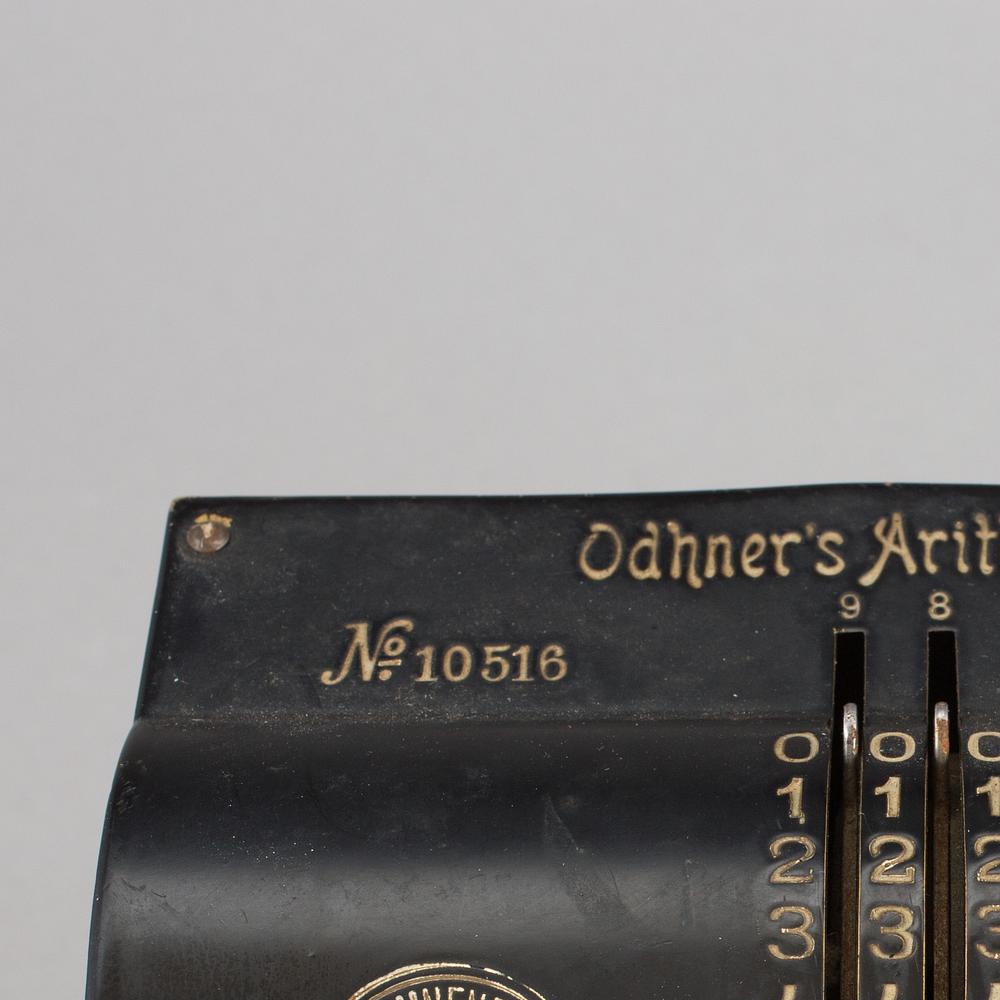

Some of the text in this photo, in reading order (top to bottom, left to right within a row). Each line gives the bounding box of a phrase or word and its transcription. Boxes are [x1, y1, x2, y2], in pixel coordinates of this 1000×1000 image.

[579, 520, 846, 589] Odhner's
[840, 592, 861, 620] 9
[928, 592, 951, 620] 8
[415, 644, 568, 682] 10516
[774, 732, 819, 762] 0
[870, 732, 915, 762] 0
[776, 777, 805, 819] 1
[874, 776, 901, 817] 1
[769, 835, 816, 884] 2
[869, 835, 916, 884] 2
[768, 906, 815, 959] 3
[869, 905, 915, 959] 3
